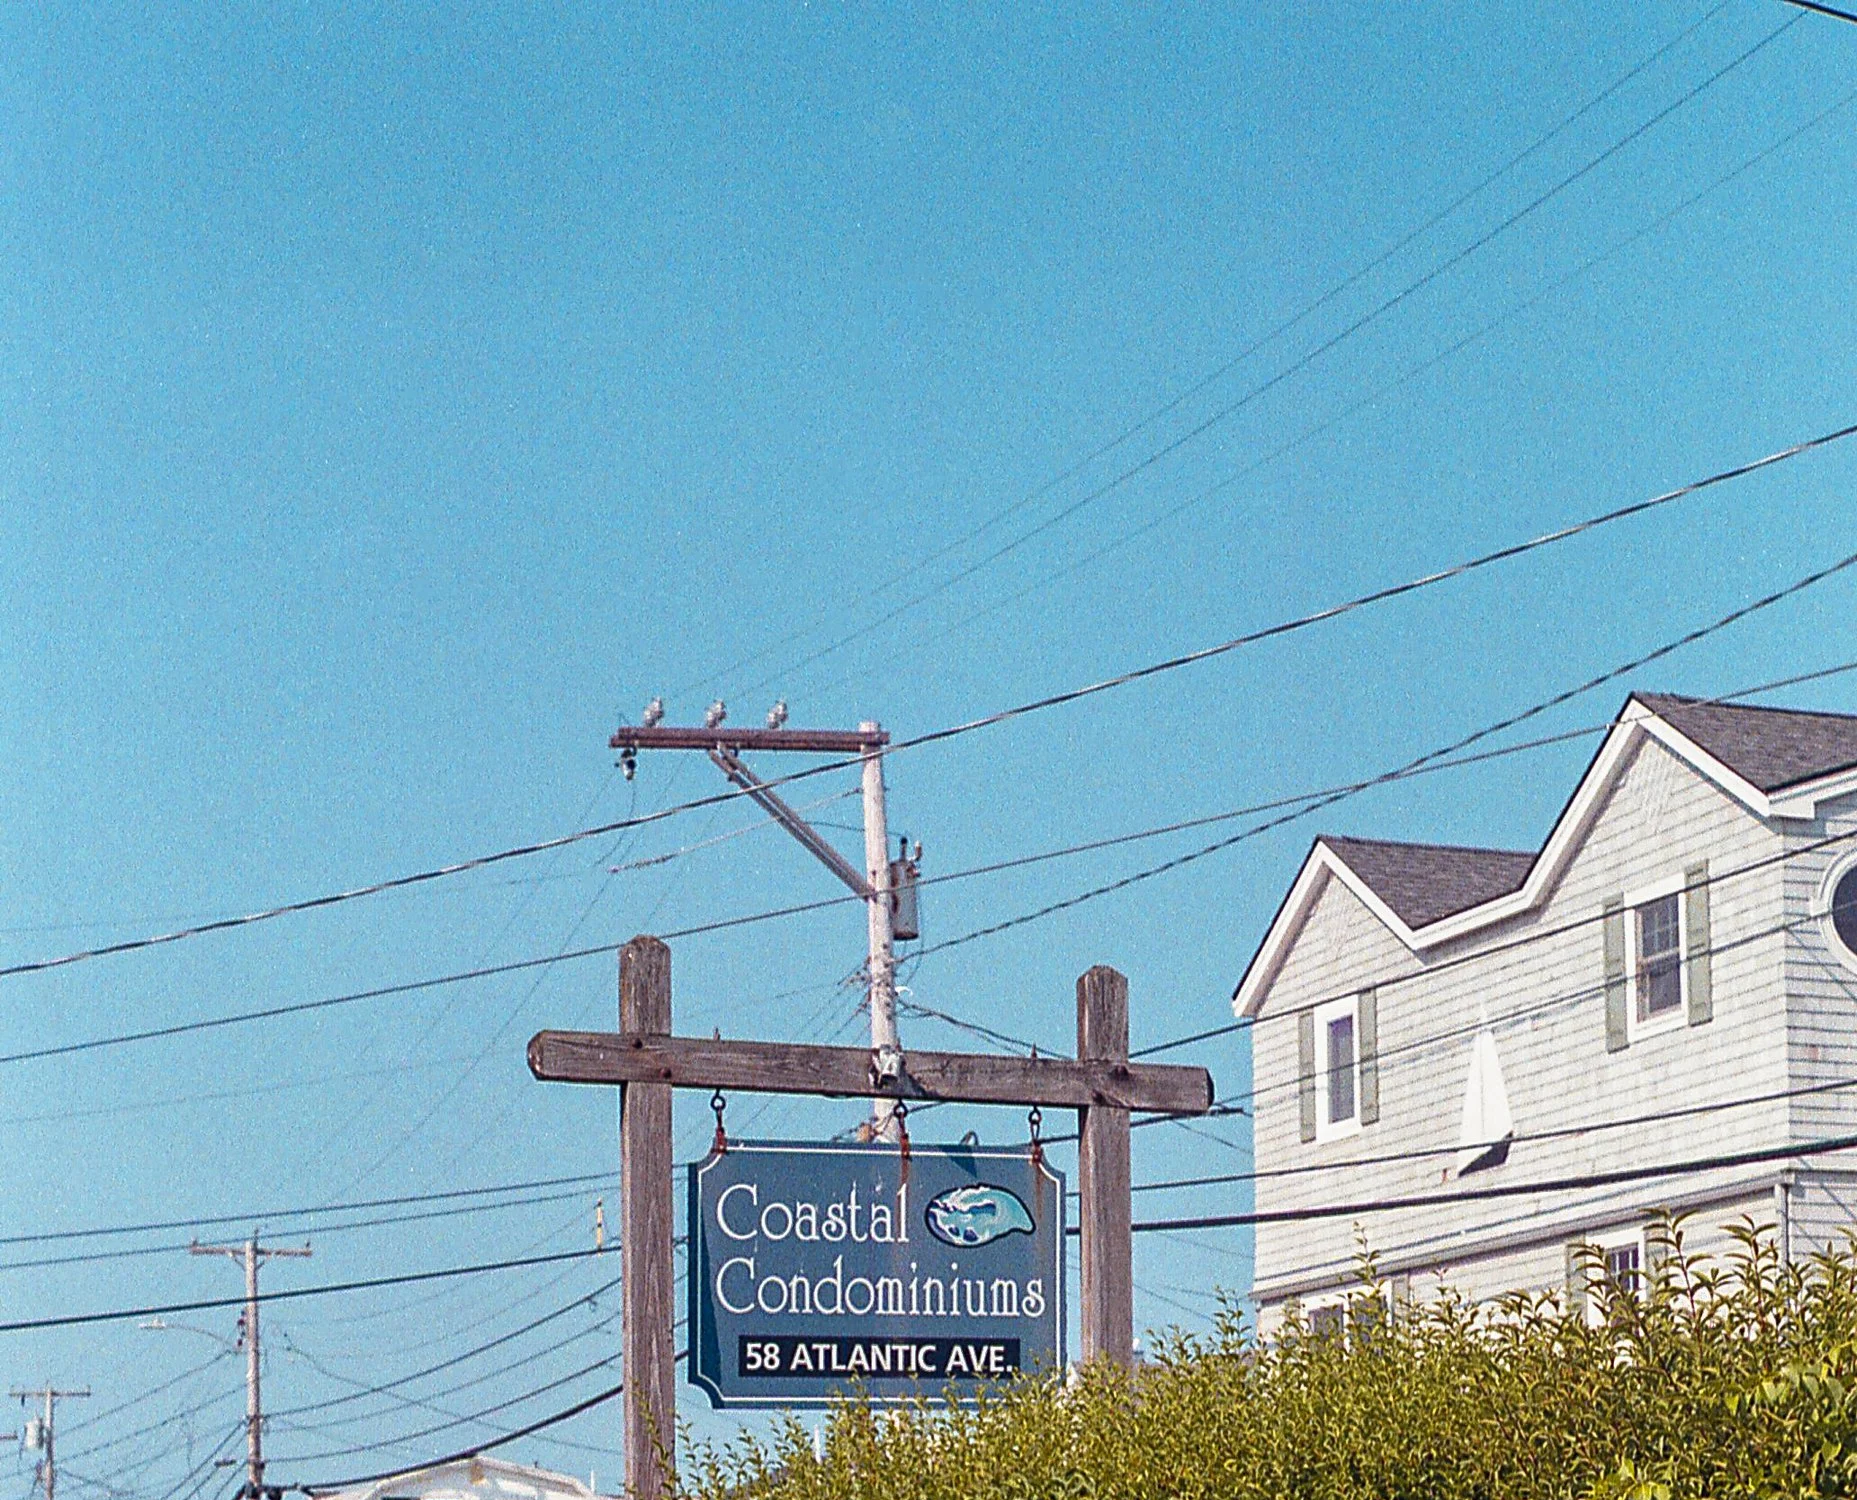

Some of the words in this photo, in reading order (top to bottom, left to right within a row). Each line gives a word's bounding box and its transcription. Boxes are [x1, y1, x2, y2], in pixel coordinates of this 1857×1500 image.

[717, 1183, 909, 1243] Coastal
[716, 1255, 1046, 1318] Condominiums
[746, 1343, 780, 1370] 58
[790, 1344, 937, 1371] ATLANTIC
[945, 1345, 1014, 1373] AVE.
